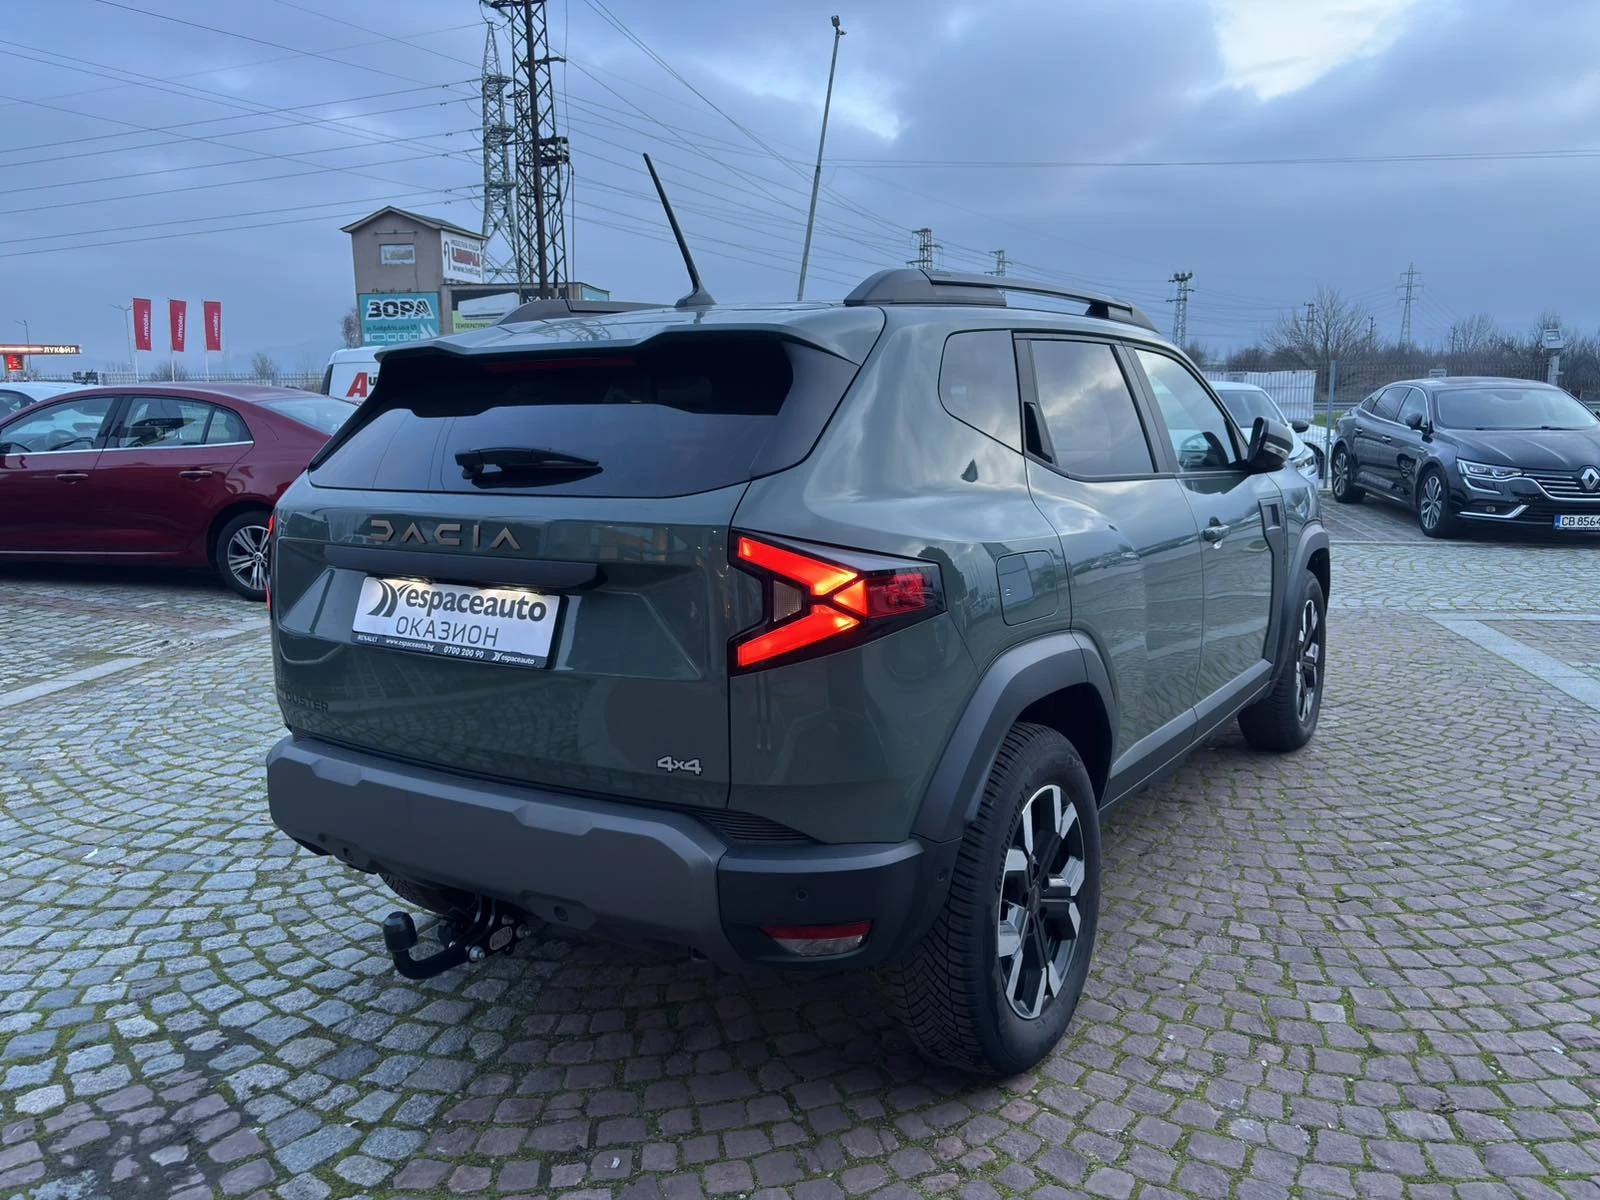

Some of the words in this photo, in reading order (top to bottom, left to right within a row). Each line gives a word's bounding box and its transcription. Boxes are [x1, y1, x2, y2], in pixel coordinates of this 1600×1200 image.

[367, 300, 433, 319] ЗОРА
[1562, 516, 1575, 526] CB
[369, 519, 520, 549] DACIA
[406, 588, 547, 621] espaceauto
[396, 616, 499, 647] ОКАЗИОН
[385, 639, 434, 651] www.espaceauto.bg
[444, 646, 460, 655] 0700
[461, 648, 474, 656] 200
[475, 650, 484, 658] 90
[501, 654, 535, 664] espaceauto
[286, 691, 329, 712] DUSTER
[657, 756, 701, 774] 4x4
